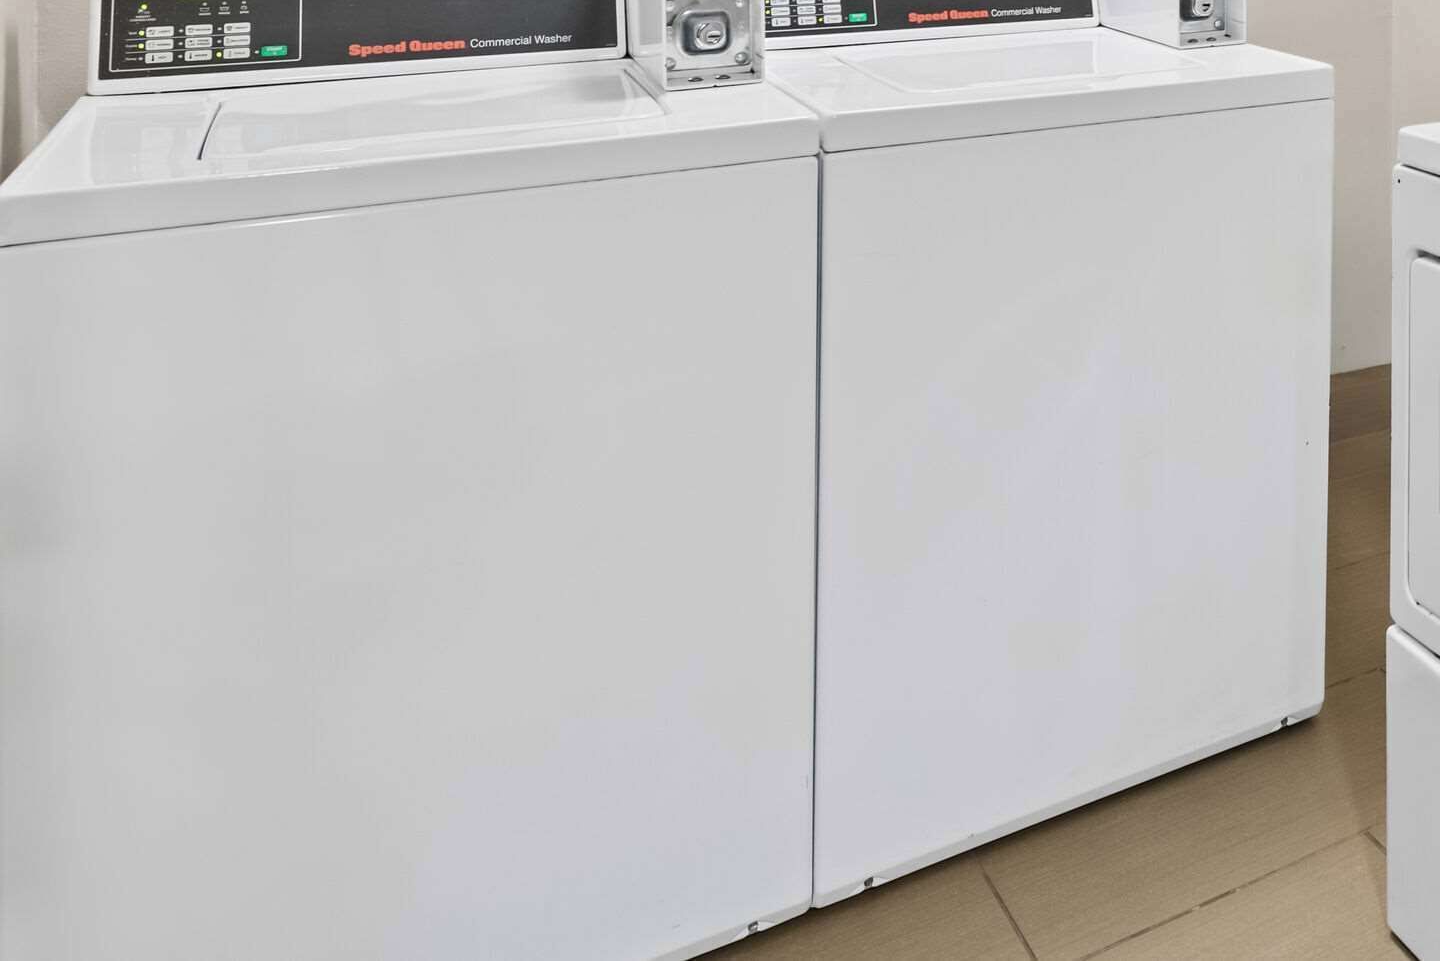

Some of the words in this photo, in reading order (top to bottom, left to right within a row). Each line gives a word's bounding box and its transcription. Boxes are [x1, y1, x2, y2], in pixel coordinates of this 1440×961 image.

[908, 10, 948, 24] Speed
[949, 8, 989, 20] Queen
[990, 7, 1034, 18] Commercial
[1035, 5, 1062, 15] Washer
[348, 41, 406, 58] Speed
[408, 39, 466, 53] Queen
[469, 35, 532, 49] Commercial
[533, 33, 573, 45] Washer
